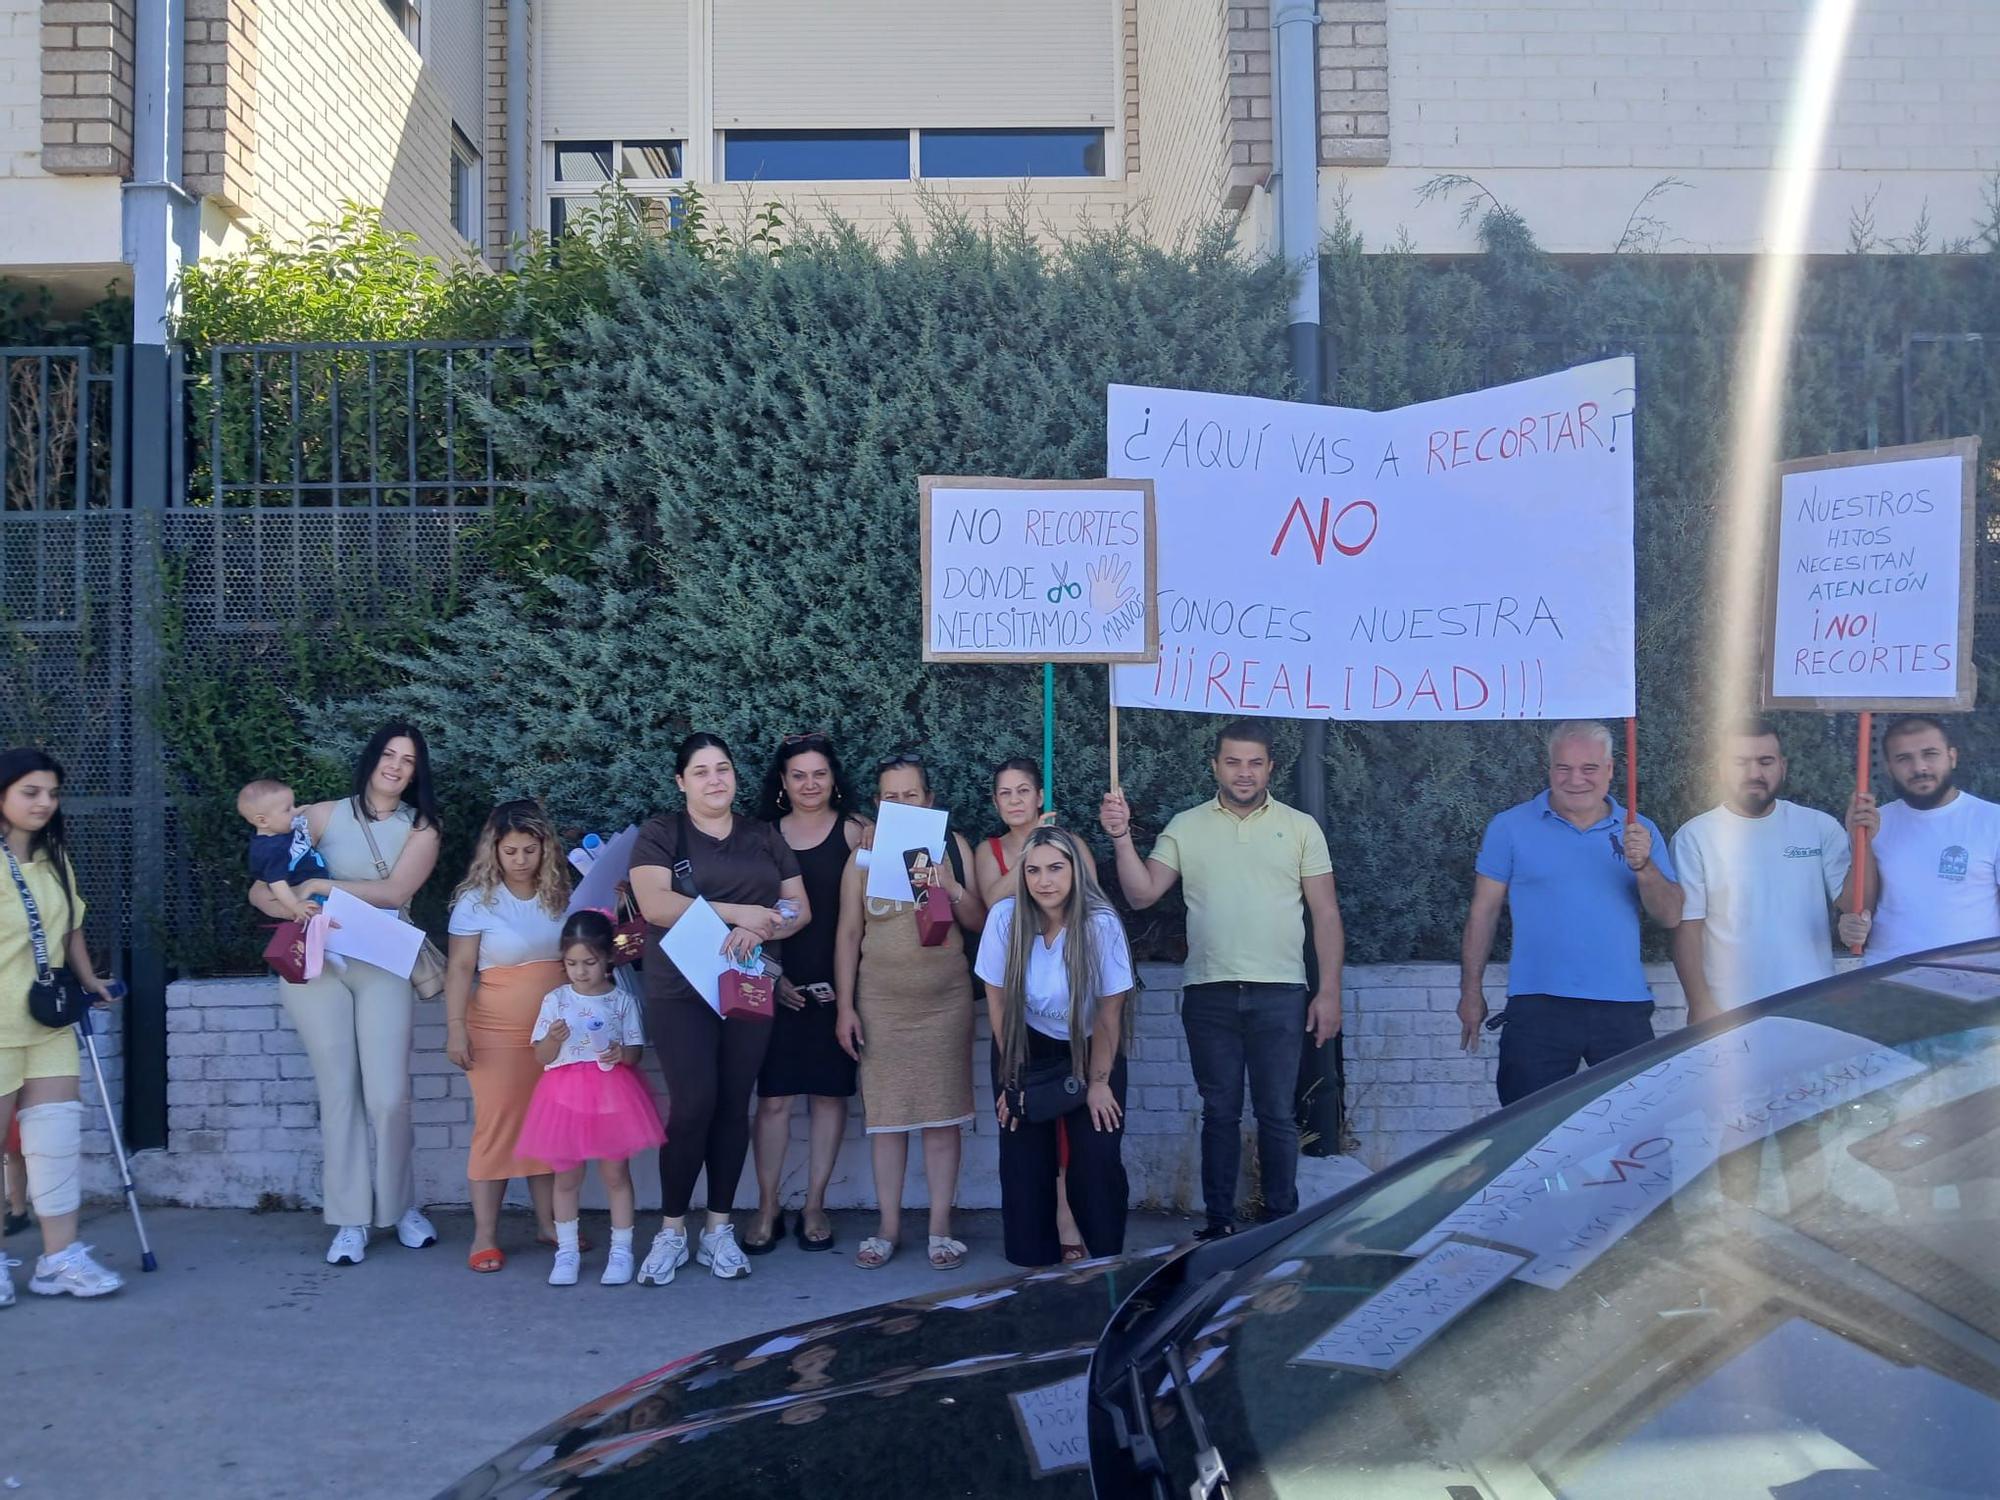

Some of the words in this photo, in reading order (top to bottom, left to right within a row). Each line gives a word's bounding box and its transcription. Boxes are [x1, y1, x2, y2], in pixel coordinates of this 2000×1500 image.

[1124, 407, 1271, 471] ¿AQUÍ
[1291, 431, 1355, 475] VAS
[1376, 440, 1399, 480] A
[1798, 485, 1935, 524] NUESTROS
[948, 508, 1001, 544] NO
[1025, 509, 1139, 546] RECORTES
[1270, 496, 1378, 565] NO
[1827, 526, 1892, 549] HIJOS
[1796, 546, 1915, 574] NECESITAN
[943, 566, 1039, 600] DONDE
[1808, 571, 1928, 601] ATENCIÓN
[1102, 593, 1146, 646] MANOS
[1350, 595, 1563, 643] NUESTRA
[1812, 609, 1877, 644] ¡NO!
[1794, 643, 1951, 676] RECORTES
[22, 888, 38, 915] LOLA
